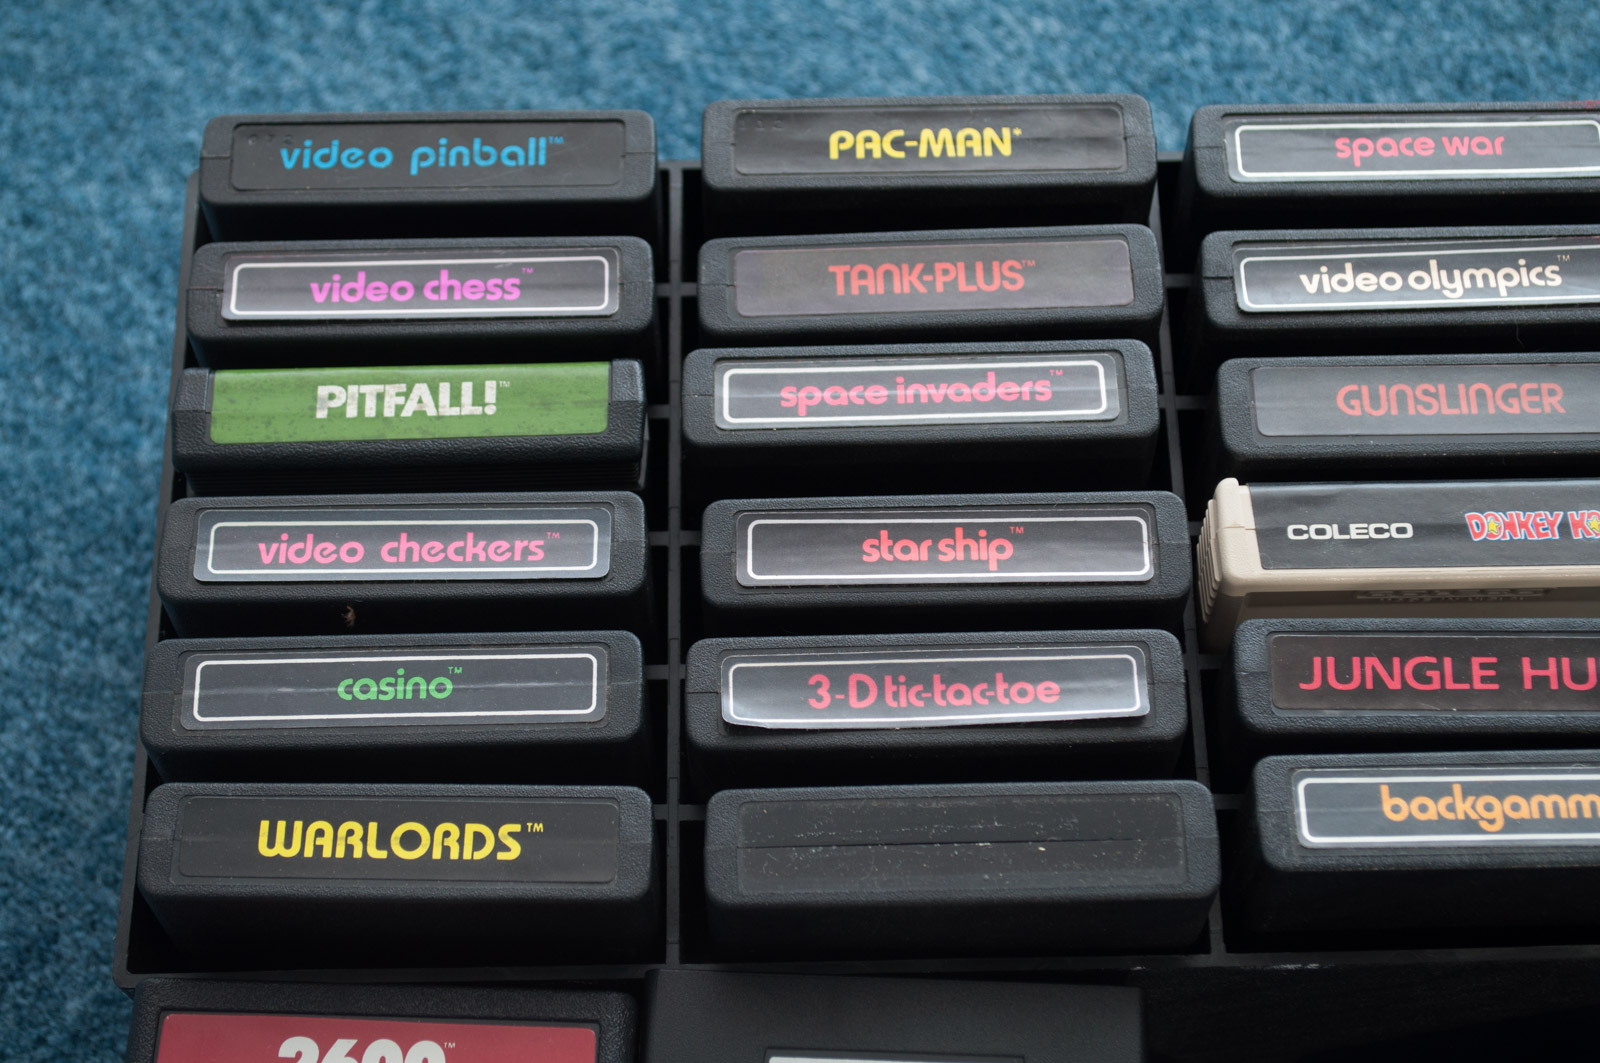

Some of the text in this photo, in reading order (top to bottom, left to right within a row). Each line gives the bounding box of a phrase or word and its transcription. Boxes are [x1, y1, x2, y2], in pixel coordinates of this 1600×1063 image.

[279, 138, 394, 170] video
[409, 136, 548, 177] pinball
[1335, 135, 1505, 167] space war
[309, 270, 416, 304] video
[422, 269, 521, 302] chess
[828, 259, 1026, 296] TANK-PLUS
[1299, 261, 1404, 295] video
[1407, 258, 1563, 300] olympics
[315, 379, 498, 420] PITFALL!
[780, 385, 888, 417] space
[895, 371, 1053, 405] invaders
[1336, 382, 1567, 417] GUNSLINGER
[1286, 522, 1414, 541] COLECO
[1465, 510, 1564, 542] DONKEY
[258, 533, 366, 565] video
[380, 531, 545, 563] checkers
[861, 530, 933, 563] star
[938, 527, 1014, 571] ship
[337, 668, 454, 701] casino
[807, 672, 1062, 710] 3-D tic-tac-toe
[1298, 655, 1600, 691] JUNGLE HU
[257, 818, 523, 861] WARLORDS
